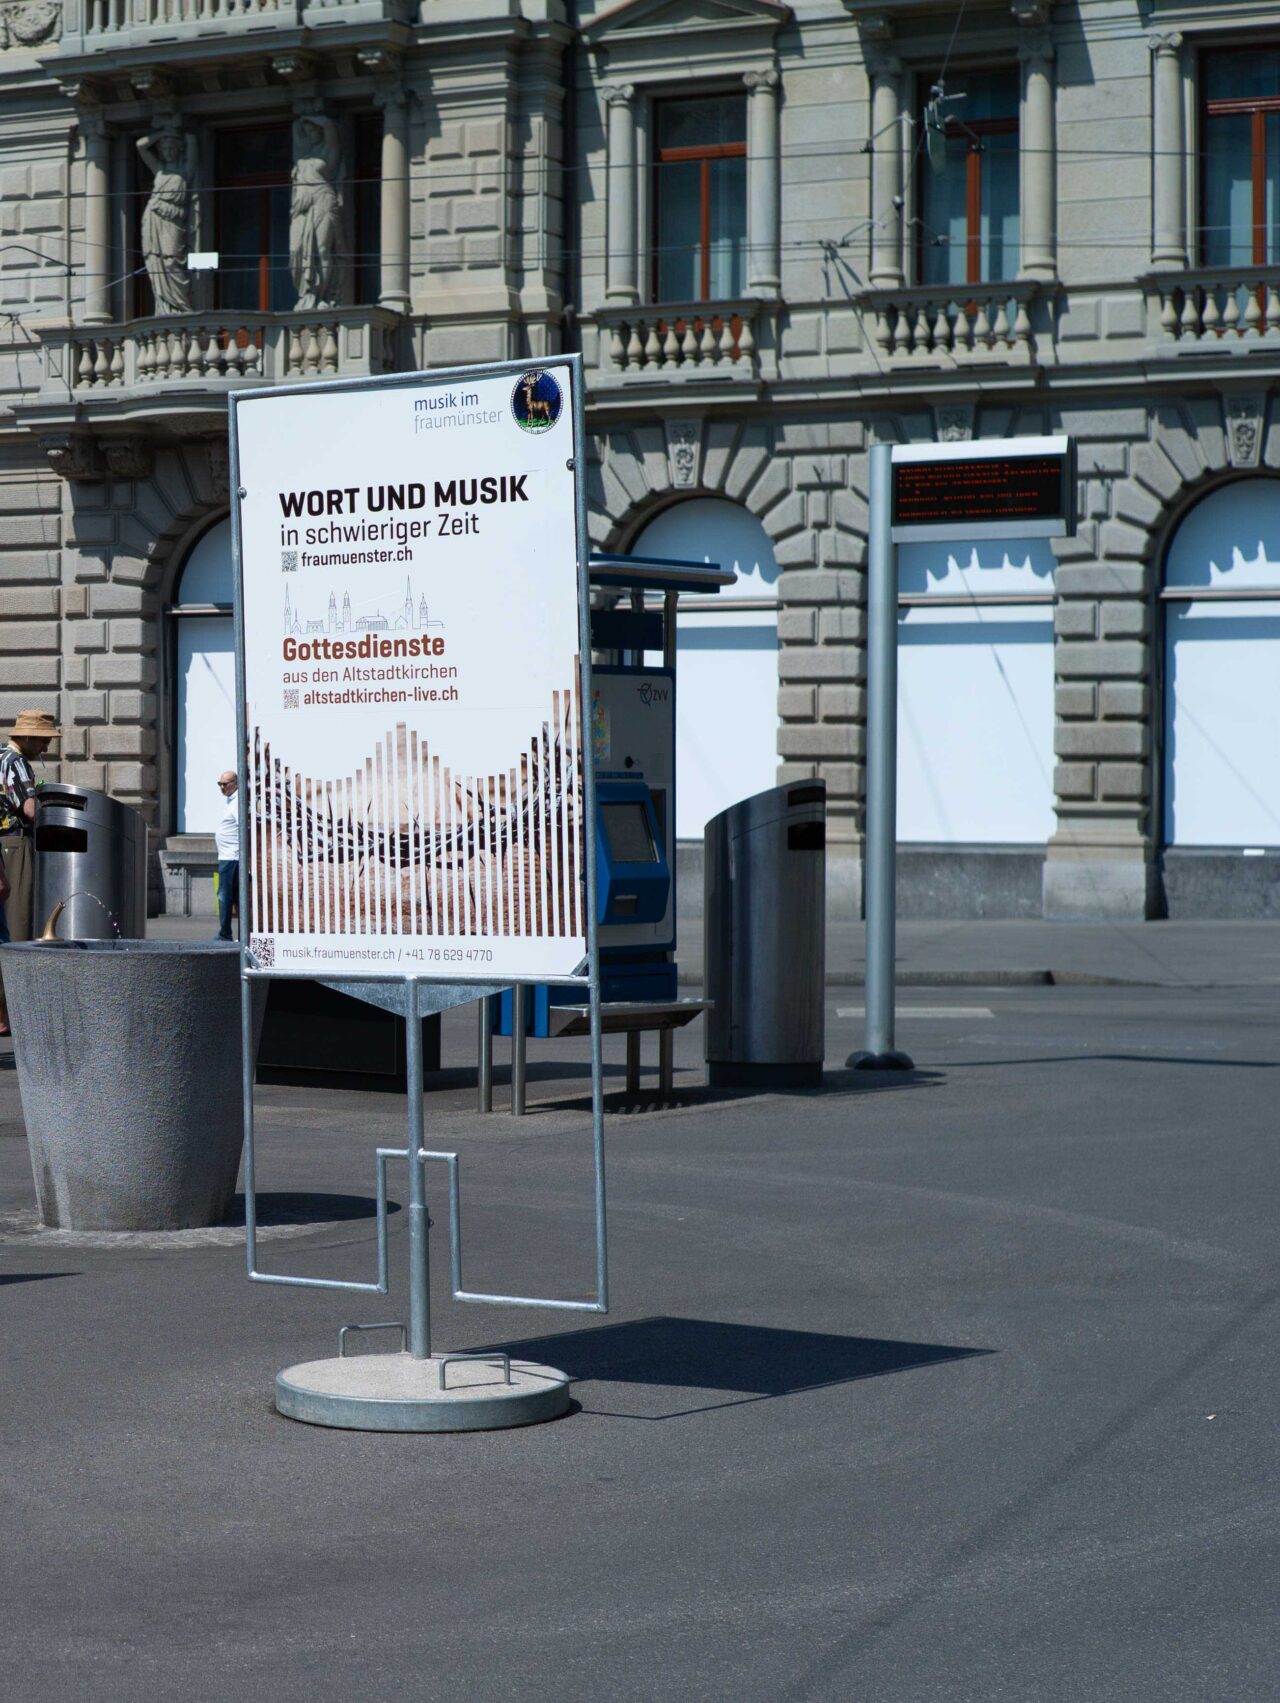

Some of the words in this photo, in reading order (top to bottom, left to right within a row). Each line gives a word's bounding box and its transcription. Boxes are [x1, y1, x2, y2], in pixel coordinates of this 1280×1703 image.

[414, 392, 457, 411] musik
[461, 391, 479, 407] im
[414, 408, 503, 434] fraumünster
[279, 487, 360, 518] WORT
[367, 483, 426, 513] UND
[434, 474, 529, 508] MUSIK
[281, 523, 299, 547] in
[305, 517, 431, 546] schwieriger
[438, 512, 480, 537] Zeit
[301, 547, 413, 568] fraumuenster.ch
[283, 633, 445, 662] Gottesdienste
[283, 669, 308, 684] aus
[312, 666, 338, 683] den
[342, 664, 458, 682] Altstadtkirchen
[303, 686, 458, 705] altstadtkirchen-live.ch
[653, 689, 668, 701] ZVV
[282, 947, 395, 961] musik.fraumuenster.ch
[397, 948, 402, 962] /
[405, 948, 424, 961] +41
[428, 948, 441, 961] 78
[443, 949, 463, 961] 629
[465, 949, 493, 962] 4770
